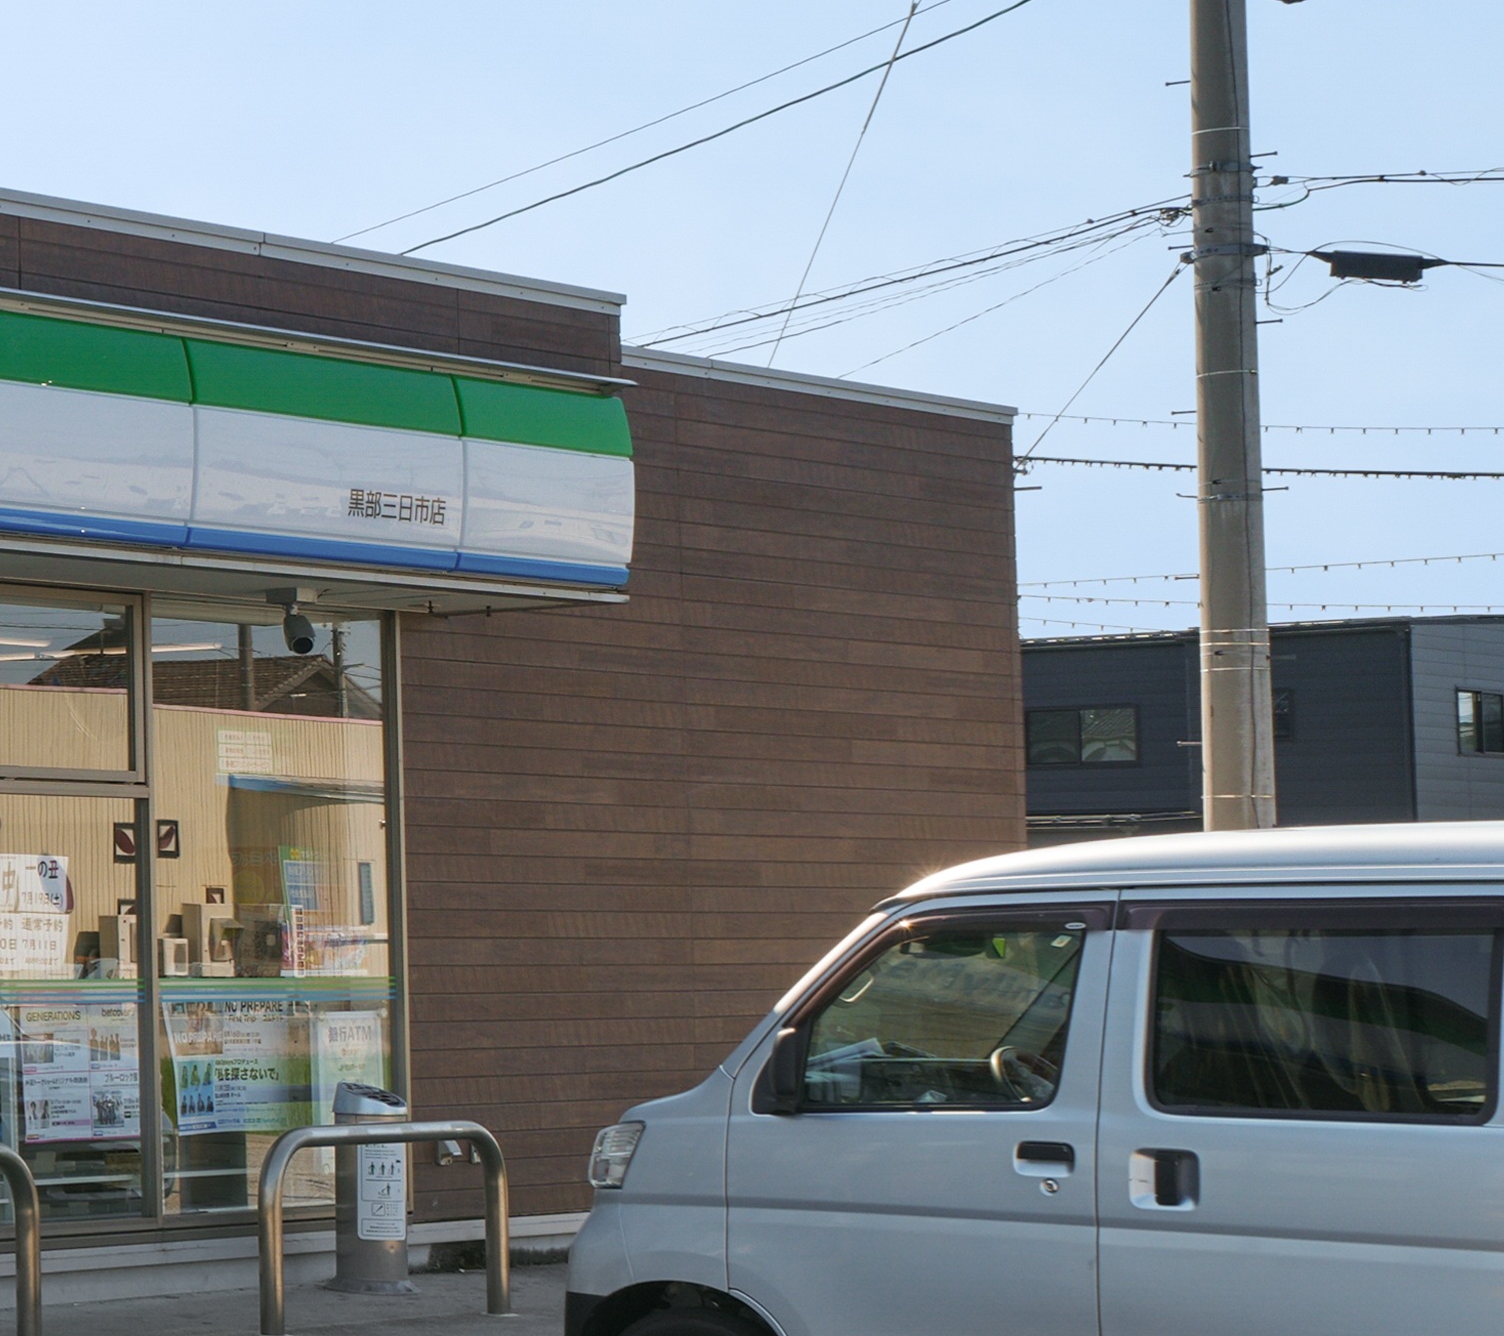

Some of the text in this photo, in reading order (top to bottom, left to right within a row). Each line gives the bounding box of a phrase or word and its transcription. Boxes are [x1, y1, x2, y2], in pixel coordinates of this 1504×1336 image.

[348, 488, 447, 526] 黒部三日市店
[25, 860, 59, 879] 一の丑
[240, 1001, 283, 1013] PREPARE
[26, 1011, 81, 1022] GENERATIONS
[329, 1025, 372, 1043] 銀行ATM
